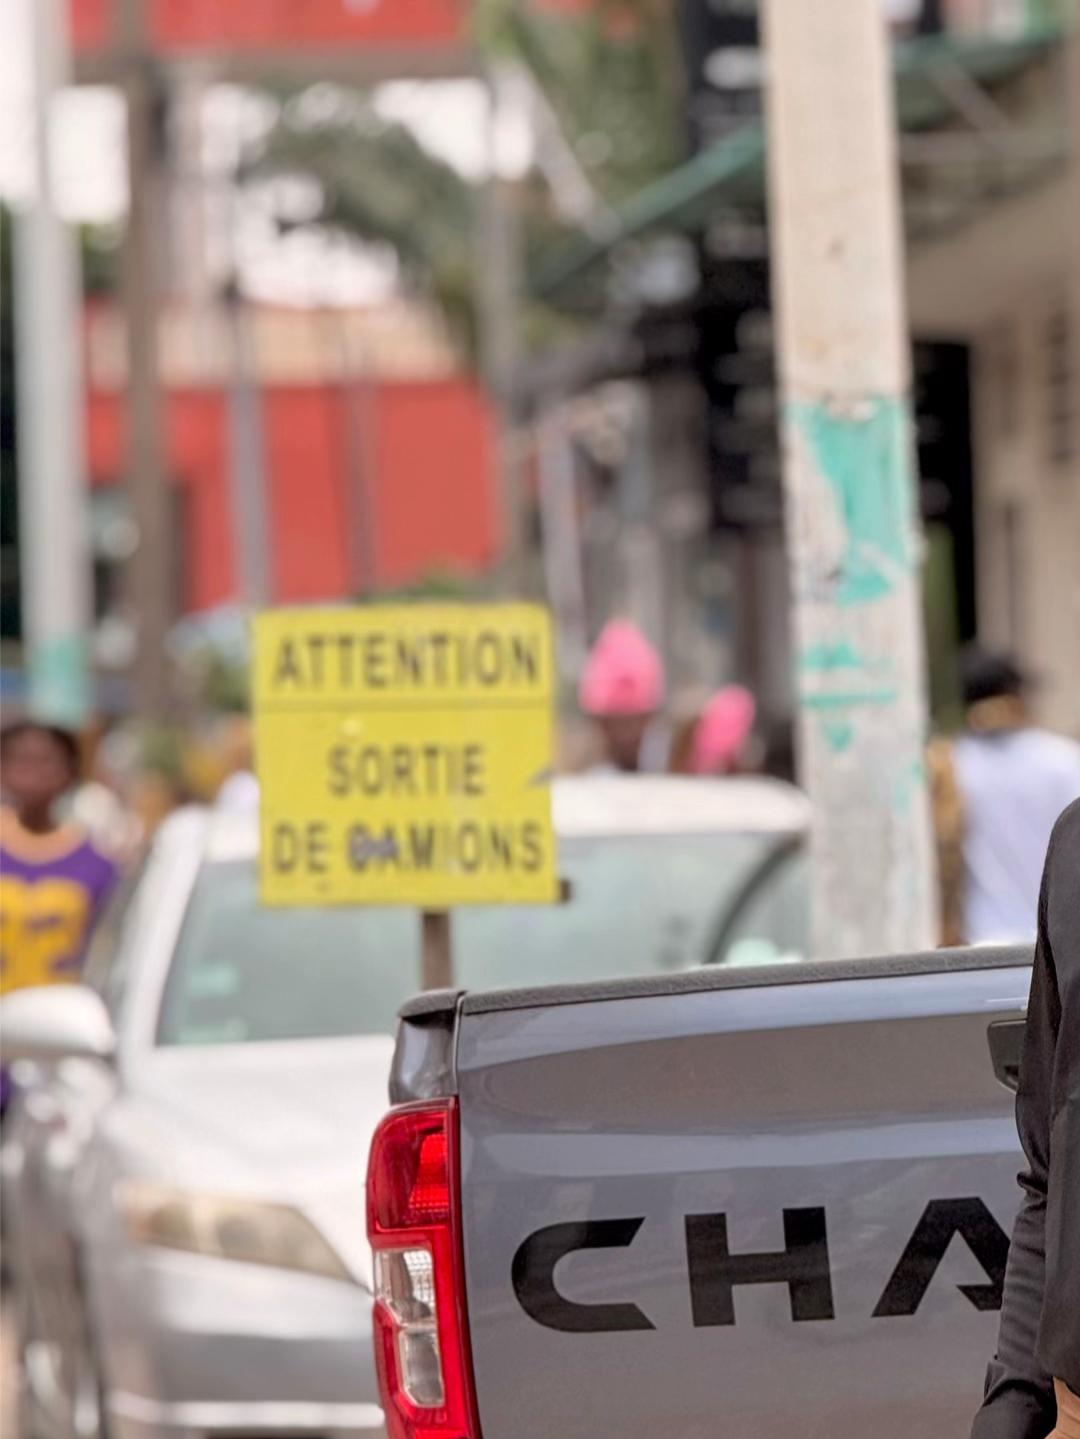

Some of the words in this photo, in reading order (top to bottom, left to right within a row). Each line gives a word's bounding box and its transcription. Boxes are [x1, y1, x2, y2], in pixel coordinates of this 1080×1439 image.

[274, 631, 538, 689] ATTENTION
[327, 743, 485, 797] SORTIE
[273, 820, 328, 874] DE
